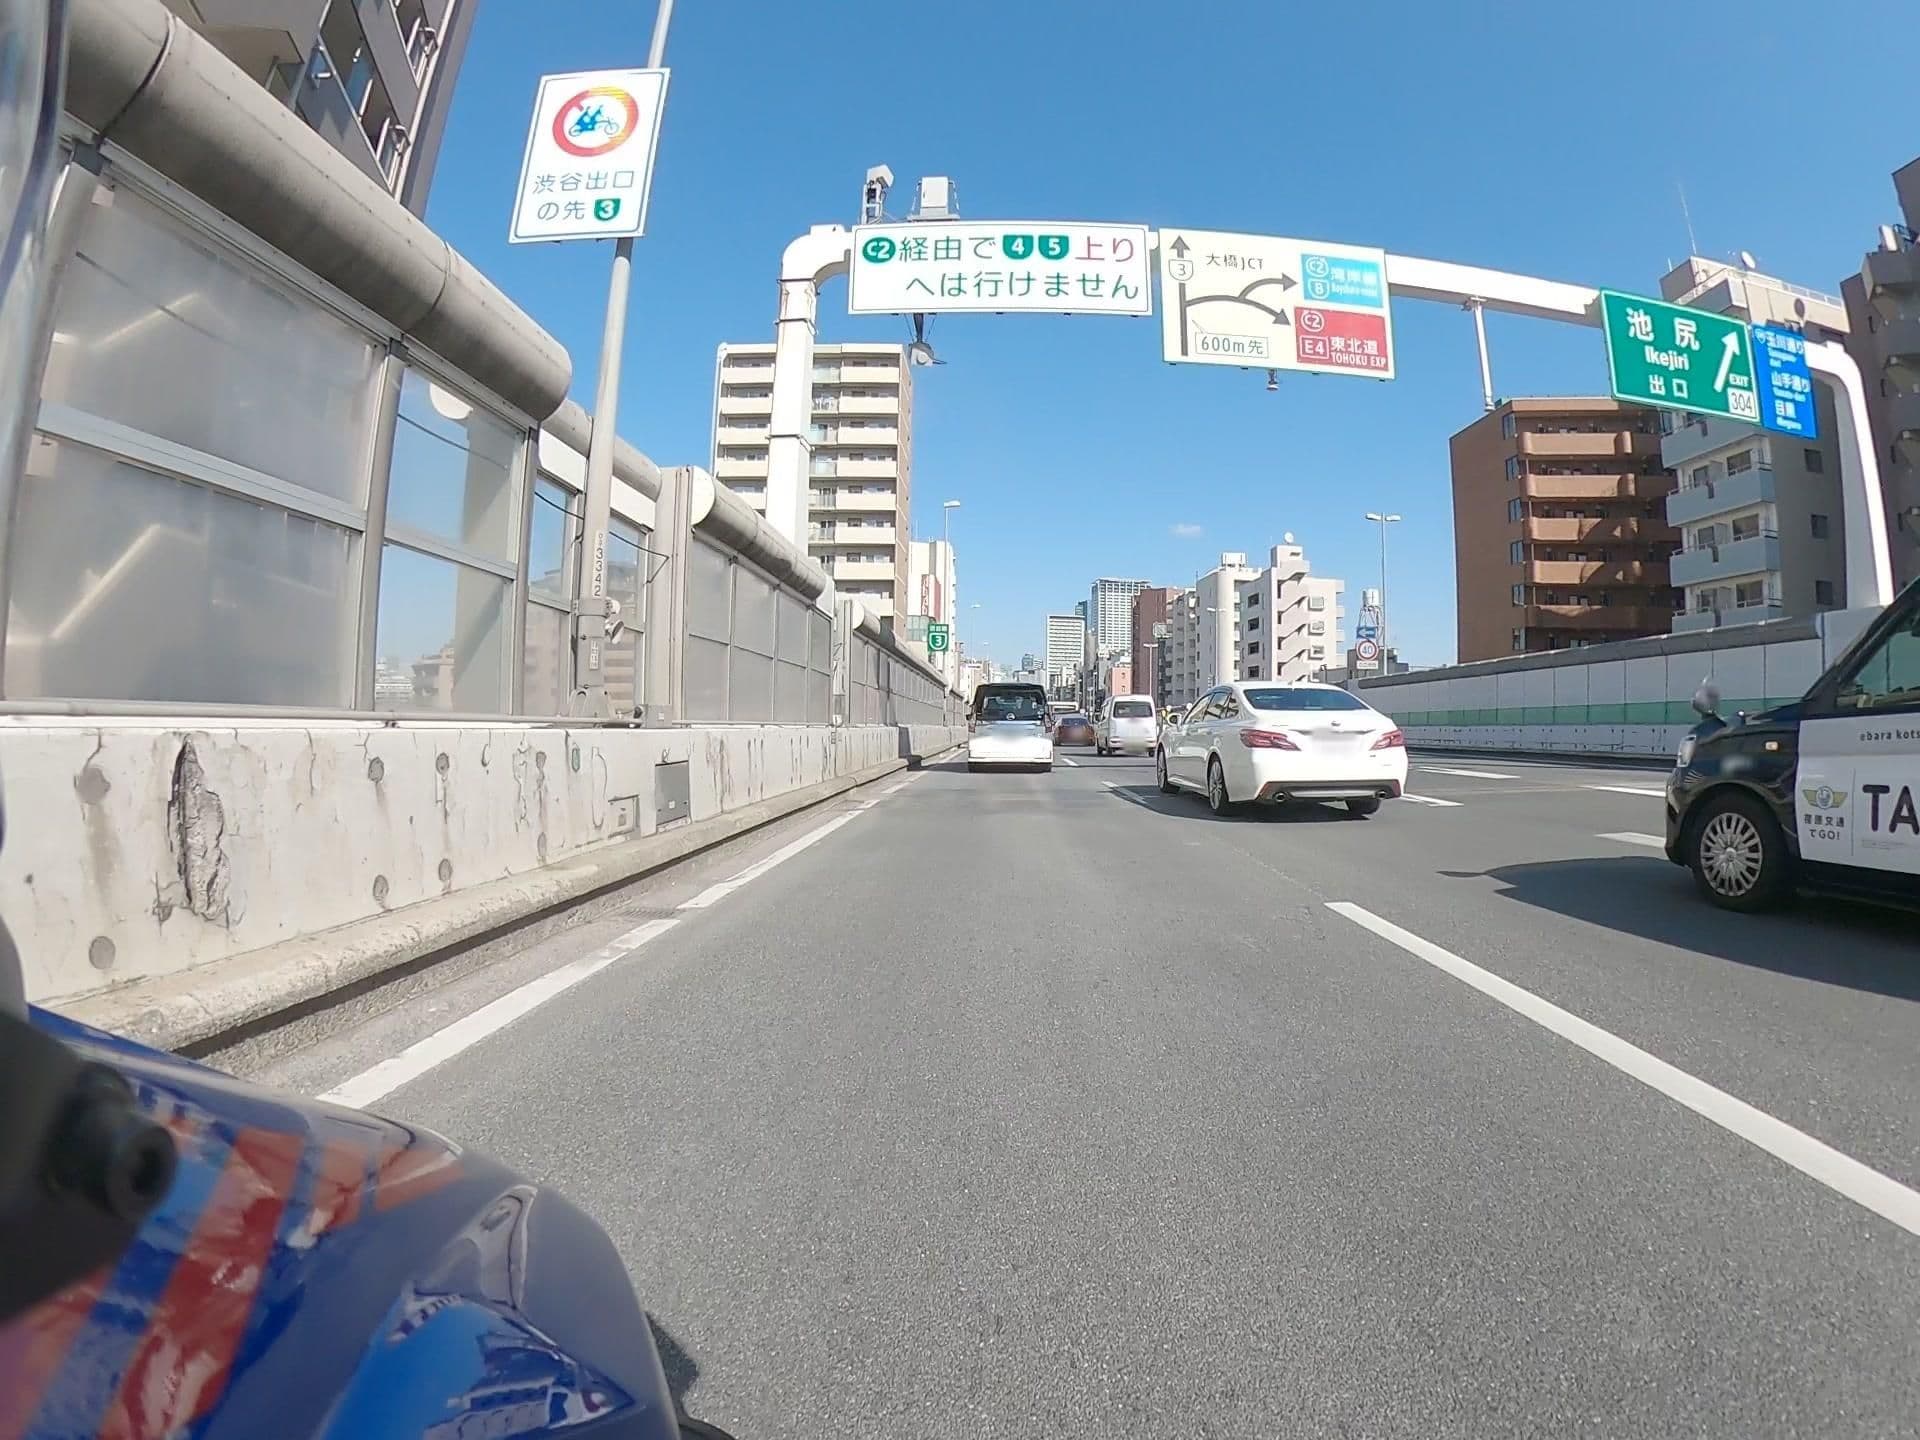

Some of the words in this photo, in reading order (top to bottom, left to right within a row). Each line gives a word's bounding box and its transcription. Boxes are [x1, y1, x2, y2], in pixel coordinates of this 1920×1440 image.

[532, 171, 635, 194] 渋谷出口
[537, 200, 605, 221] の先
[599, 200, 615, 218] 3
[866, 241, 891, 259] C2
[899, 235, 996, 262] 経由で
[1006, 238, 1025, 253] 4
[1075, 235, 1134, 263] 上り
[906, 271, 1139, 299] へは行けません
[1304, 314, 1321, 329] C2
[1625, 307, 1701, 351] 池尻
[1200, 337, 1264, 355] 600m先
[1304, 340, 1325, 355] E4
[1330, 336, 1379, 355] 東北道
[1331, 352, 1368, 366] TOHOKU
[1370, 356, 1387, 368] EXP
[1644, 345, 1690, 372] Ikejiri
[1649, 374, 1689, 399] 出口
[1729, 373, 1749, 388] EXIT
[1731, 394, 1753, 413] 304
[1361, 645, 1373, 655] 40
[1860, 731, 1892, 741] ebara
[1862, 784, 1920, 836] TA
